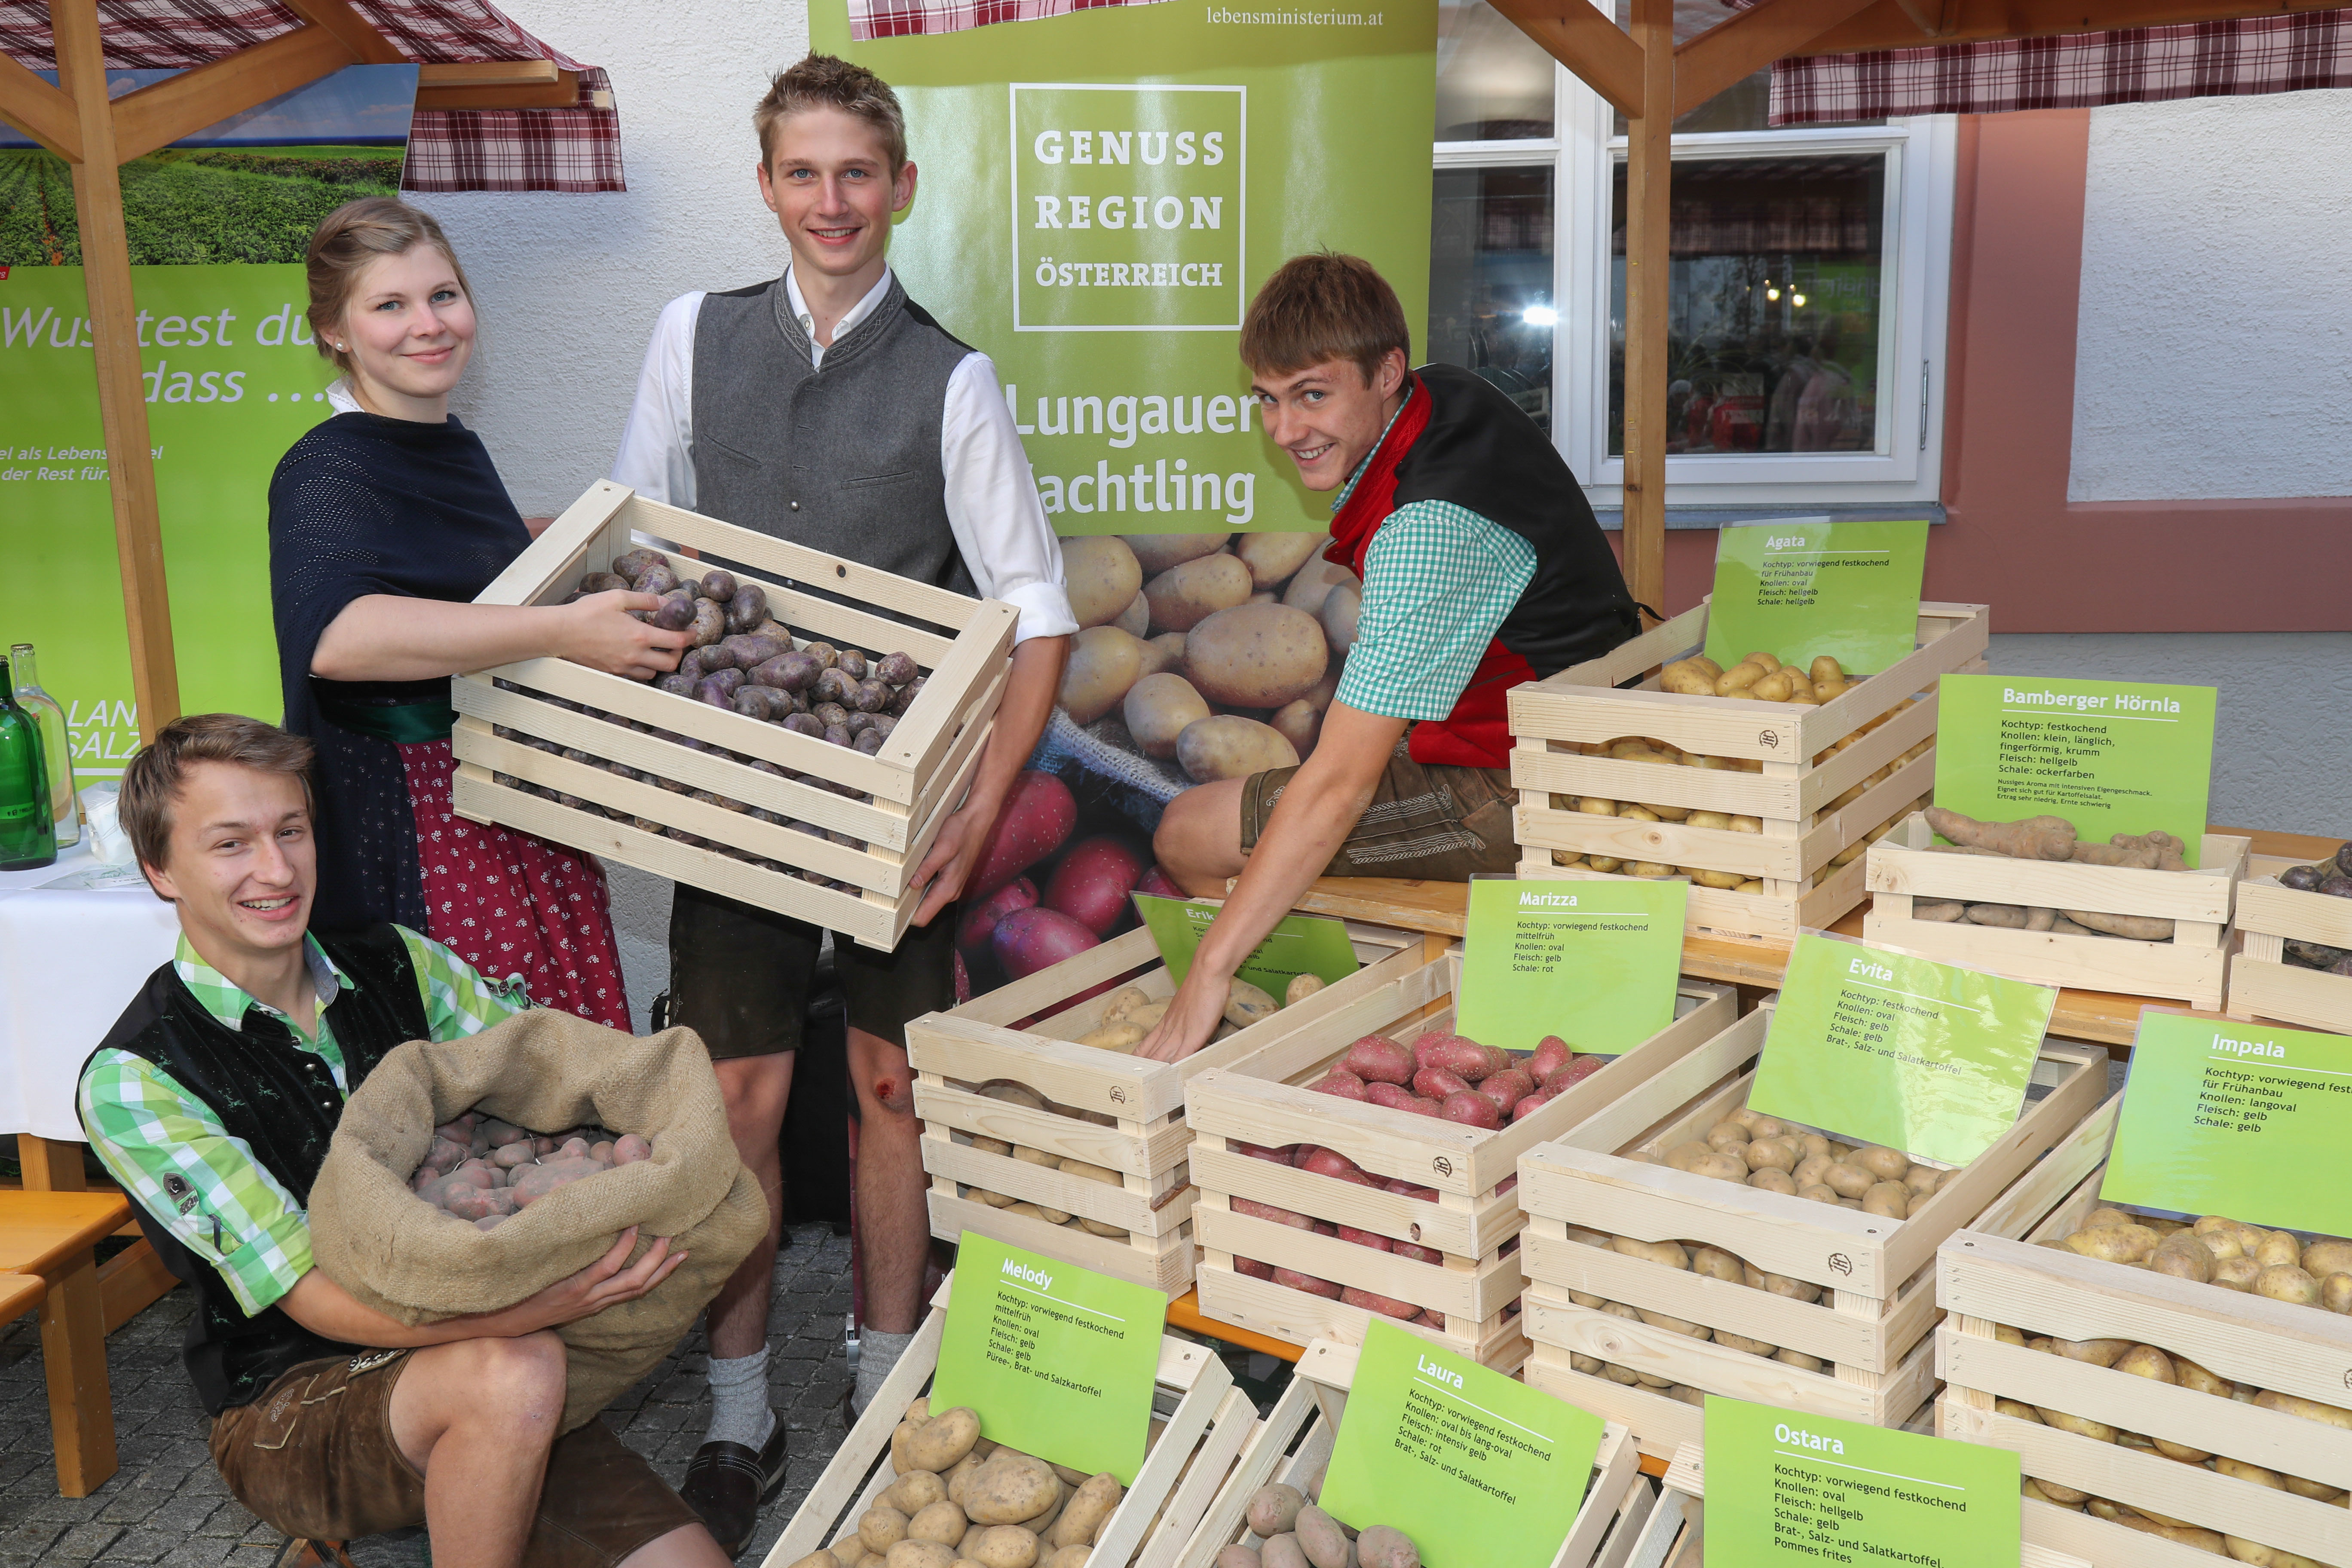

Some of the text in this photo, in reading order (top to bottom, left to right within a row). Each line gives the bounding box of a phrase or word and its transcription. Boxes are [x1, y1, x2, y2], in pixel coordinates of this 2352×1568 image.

[1207, 7, 1382, 25] lebensministerium.at
[1035, 130, 1223, 165] GENUSS
[1035, 196, 1222, 229] REGION
[1036, 257, 1222, 286] ÖSTERREICH
[142, 360, 246, 403] dass
[1006, 384, 1259, 448] Lungauer
[18, 446, 42, 460] als
[2, 467, 32, 481] der
[37, 466, 75, 481] Rest
[1029, 459, 1255, 524] achtling
[1766, 536, 1805, 550] Agata
[2004, 688, 2180, 713] Bamberger Hörnla
[67, 700, 139, 727] LAN
[2002, 720, 2106, 733] Kochtyp: festkochend
[2000, 742, 2099, 756] fingerförmig, krumm
[2001, 732, 2114, 747] Knollen: klein, länglich,
[2000, 754, 2077, 766] Fleisch: hellgelb
[1999, 765, 2094, 779] Schale: ockerfarben
[2058, 791, 2102, 799] Kartoffelsalat.
[2097, 787, 2152, 796] Eigengeschmack.
[1519, 892, 1577, 906] Marizza
[1185, 908, 1217, 920] Erik
[1517, 922, 1550, 930] Kochtyp:
[1553, 923, 1597, 931] vorwiegend
[1546, 955, 1561, 963] gelb
[1849, 958, 1893, 981] Evita
[1838, 1001, 1895, 1020] Knollen: oval
[1841, 989, 1939, 1019] Kochtyp: festkochend
[1830, 1023, 1882, 1042] Schale: gelb
[1834, 1012, 1889, 1031] Fleisch: gelb
[1827, 1035, 1961, 1075] Brat-, Salz- und Salatkartoffel
[2212, 1034, 2285, 1058] Impala
[2203, 1080, 2282, 1097] für Frühanbau
[2206, 1068, 2352, 1093] Kochtyp: vorwiegend fest
[2197, 1104, 2267, 1120] Fleisch: gelb
[2200, 1092, 2296, 1112] Knollen: langoval
[2194, 1116, 2261, 1132] Schale: gelb
[1001, 1258, 1053, 1290] Melody
[995, 1305, 1031, 1322] mittelfrüh
[998, 1291, 1124, 1339] Kochtyp: vorwiegend festkochend
[991, 1327, 1035, 1349] Fleisch: gelb
[993, 1315, 1039, 1338] Knollen: oval
[989, 1339, 1031, 1360] Schale: gelb
[987, 1351, 1101, 1397] Püree-, Brat- und Salzkartoffel
[1418, 1354, 1463, 1389] Laura
[1406, 1401, 1512, 1458] Knollen: oval bis lang-oval
[1409, 1389, 1551, 1461] Kochtyp: vorwiegend festkochend
[1398, 1426, 1441, 1454] Schale: rot
[1402, 1414, 1486, 1461] Fleisch: intensiv gelb
[1775, 1424, 1844, 1455] Ostara
[1395, 1439, 1516, 1504] Brat-, Salz- und Salatkartoffel
[1775, 1464, 1966, 1512] Kochtyp: vorwiegend festkochend
[1775, 1479, 1844, 1502] Knollen: oval
[1775, 1493, 1863, 1521] Fleisch: hellgelb
[1775, 1508, 1839, 1530] Schale: gelb
[1775, 1522, 1804, 1539] Brat-,
[1809, 1530, 1834, 1543] Salz-
[1839, 1539, 1858, 1550] und
[1775, 1537, 1851, 1563] Pommes frites
